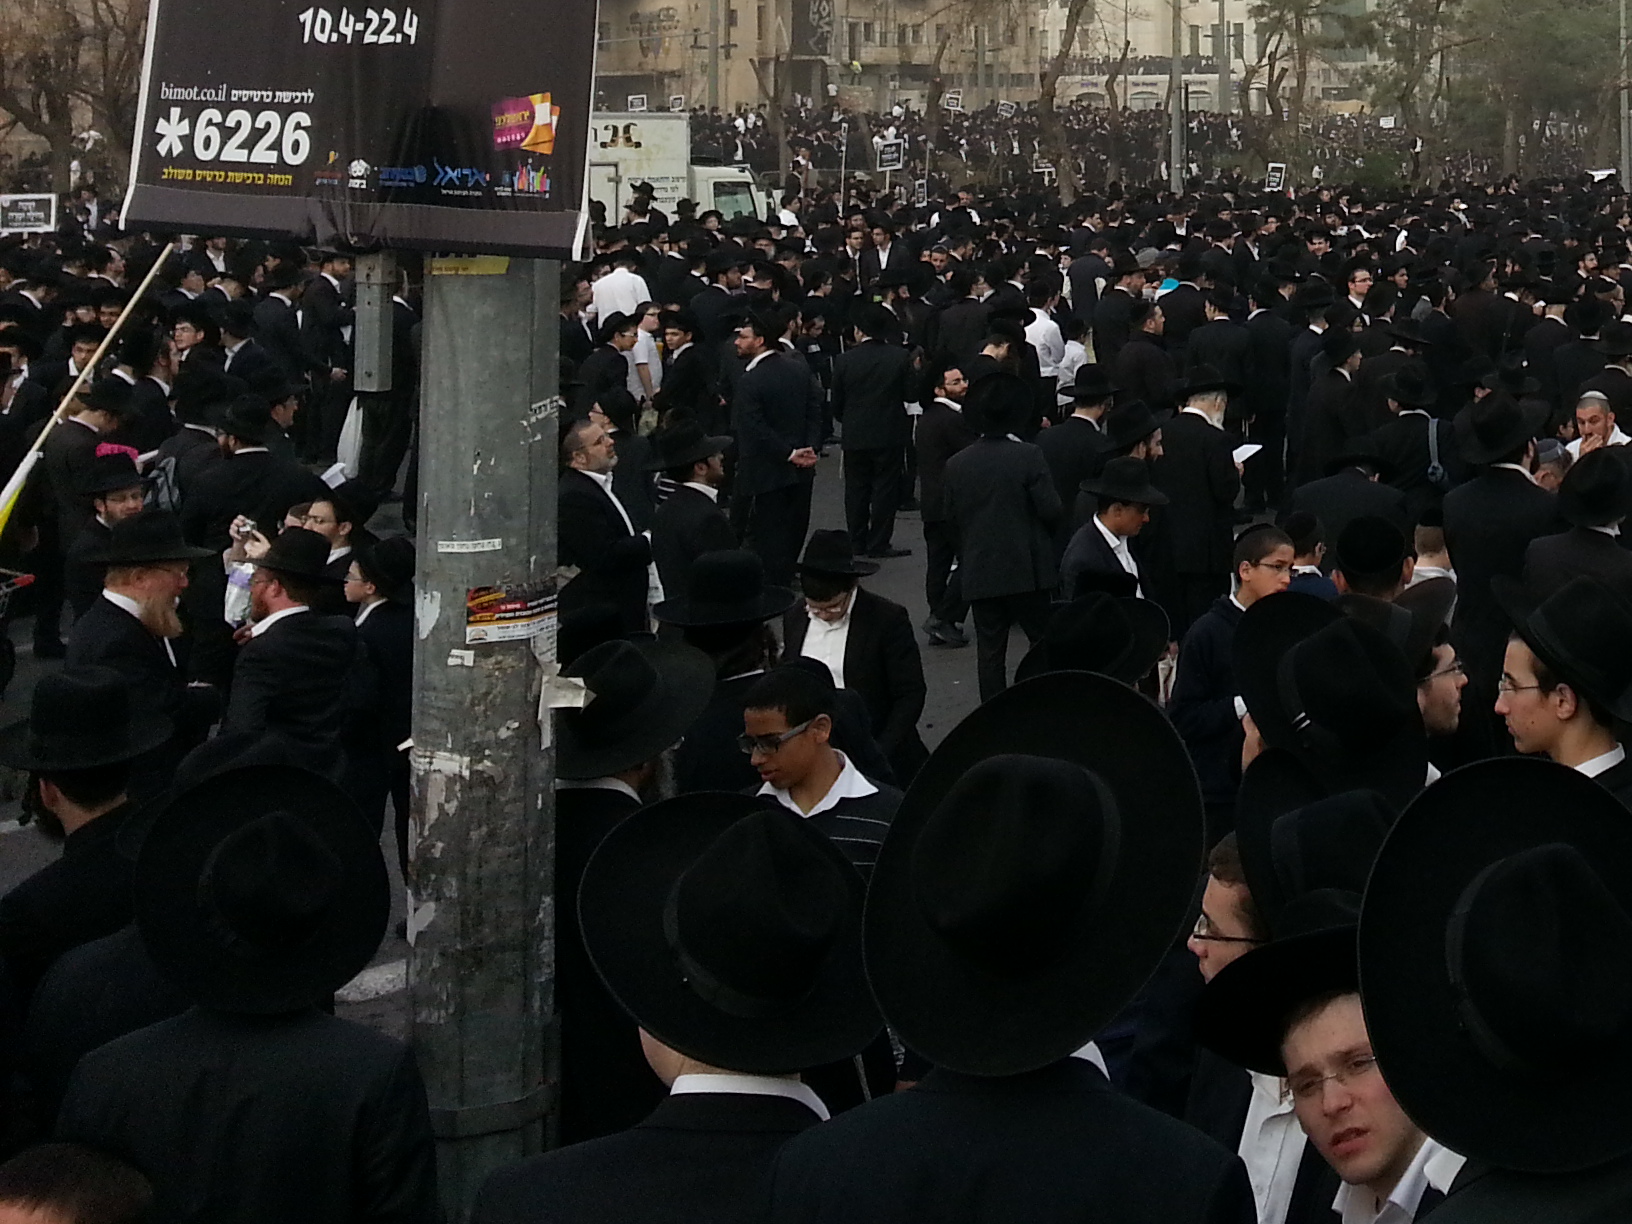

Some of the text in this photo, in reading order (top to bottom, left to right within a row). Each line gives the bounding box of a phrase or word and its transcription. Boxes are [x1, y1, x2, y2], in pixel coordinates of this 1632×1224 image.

[298, 6, 419, 45] 10.4-22.4
[160, 82, 227, 102] bimot.co.il
[231, 87, 315, 104] לרכישת כרטיסים
[161, 165, 193, 181] משולב
